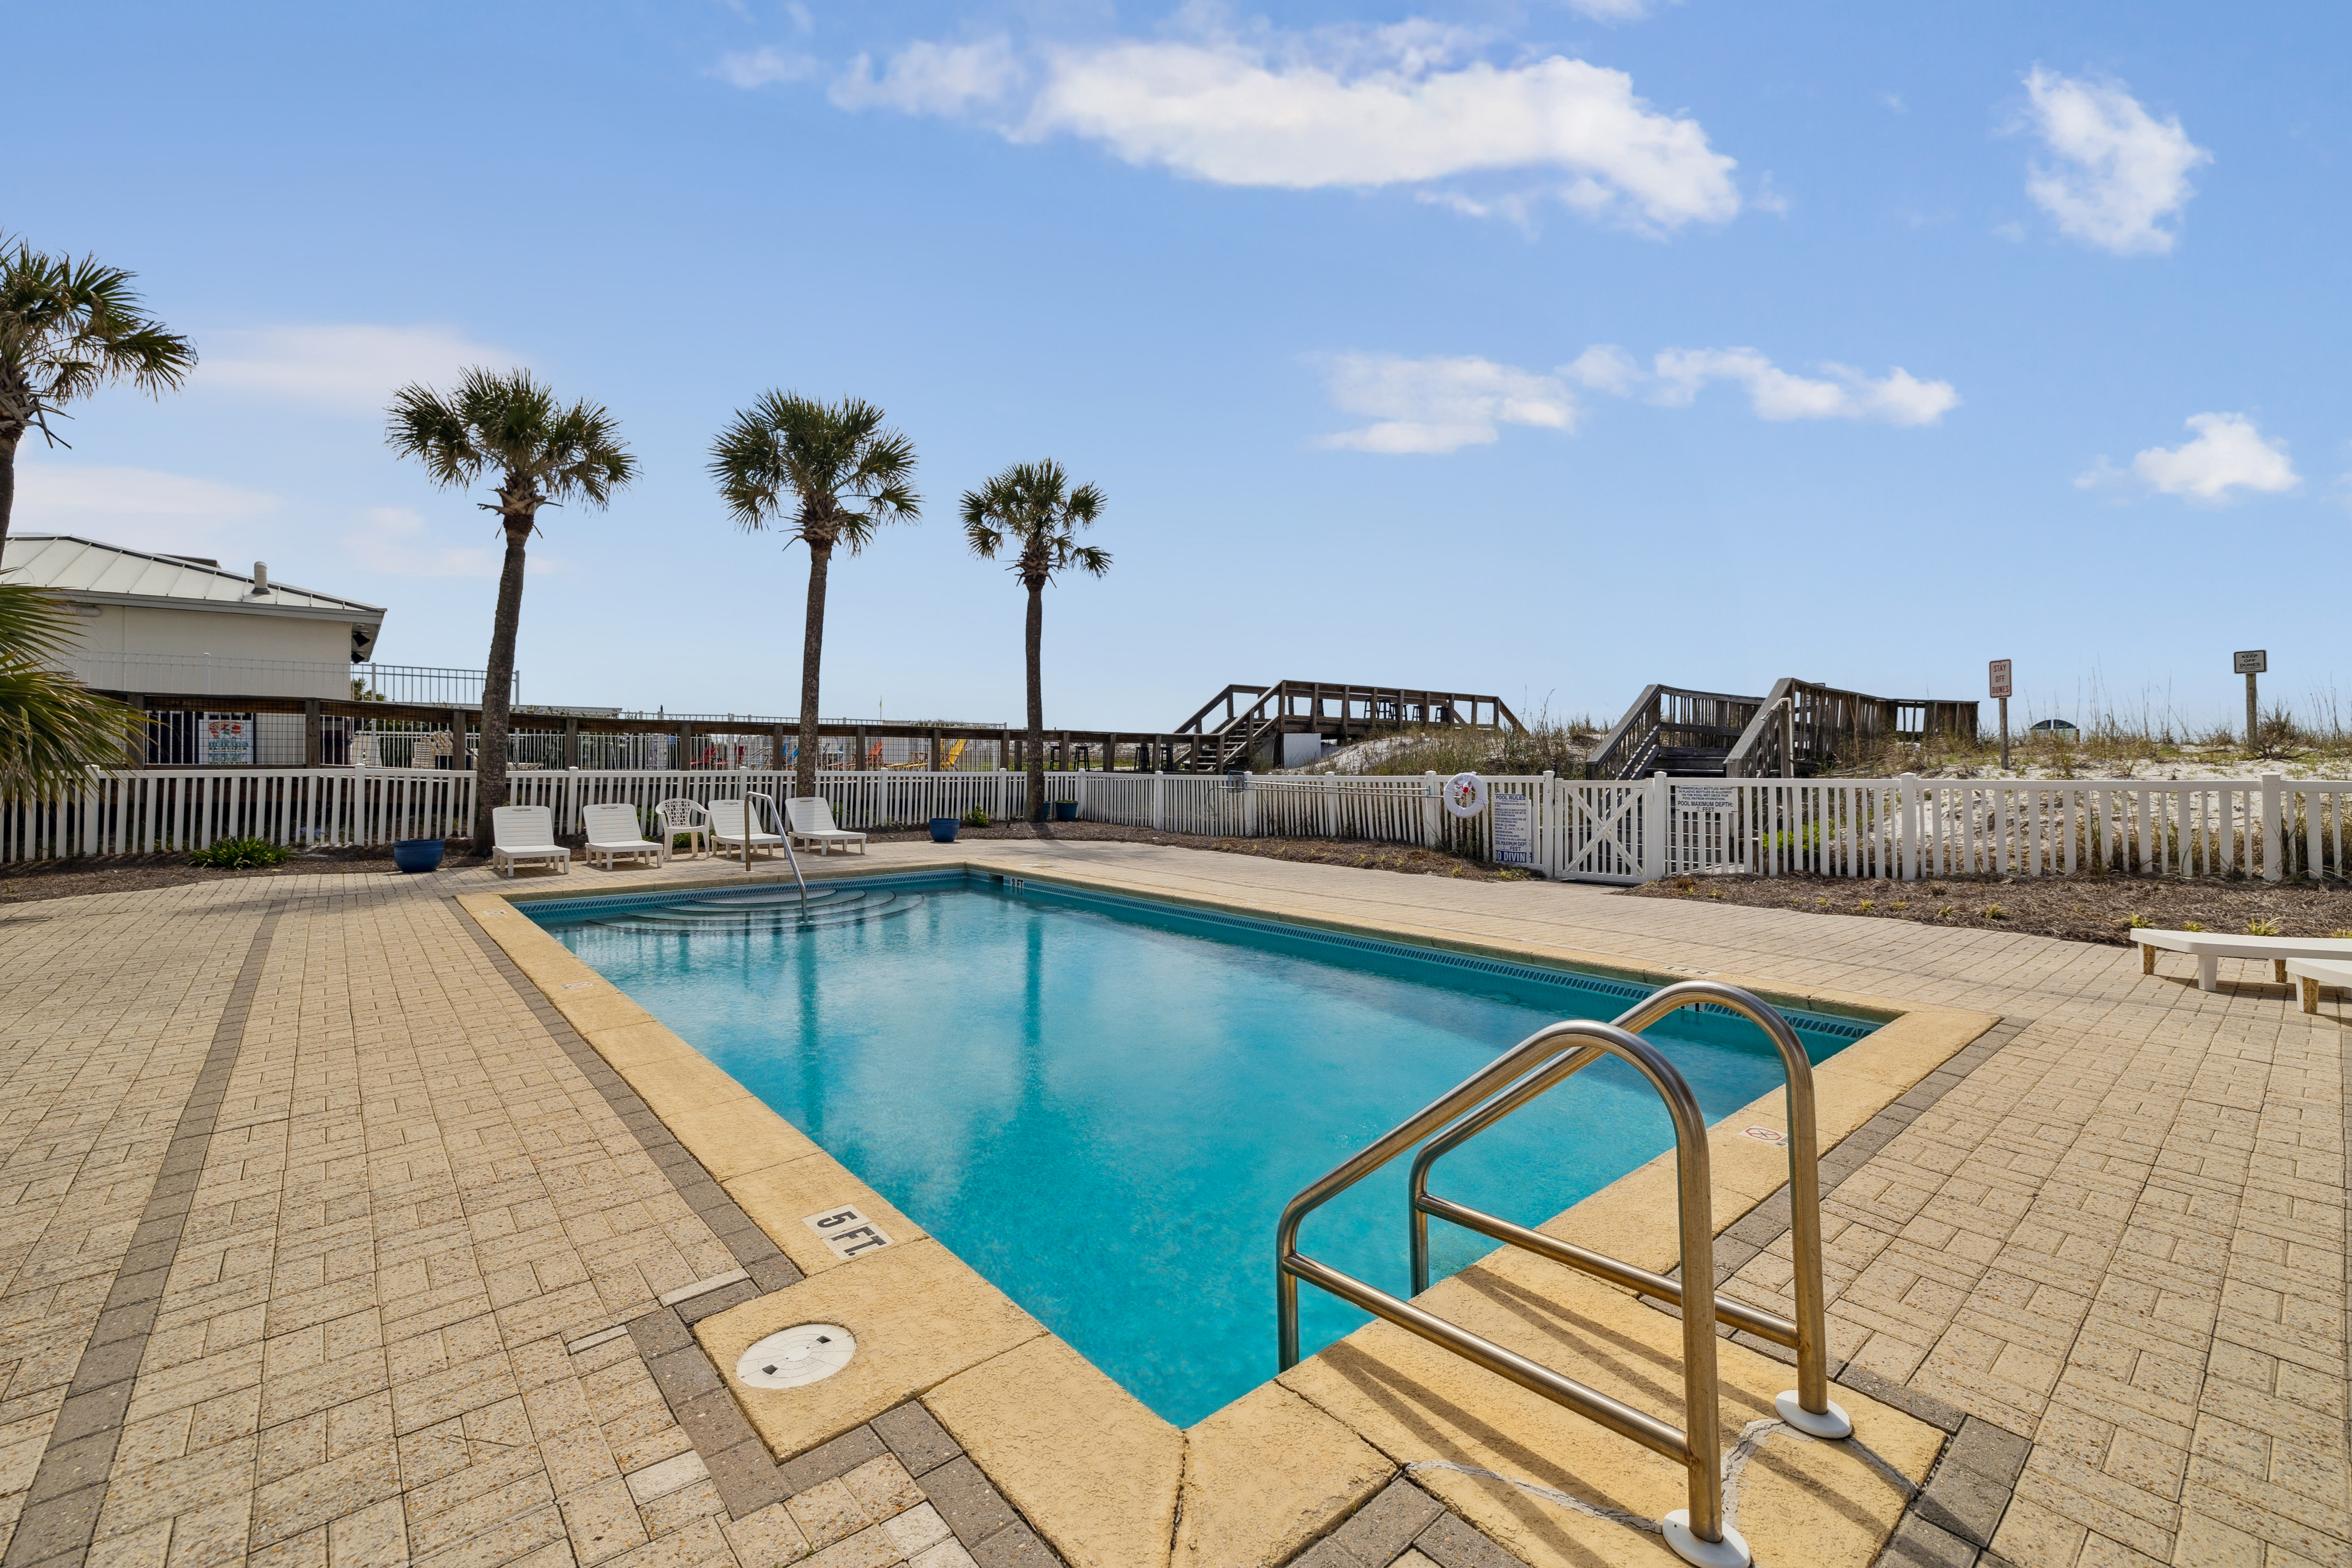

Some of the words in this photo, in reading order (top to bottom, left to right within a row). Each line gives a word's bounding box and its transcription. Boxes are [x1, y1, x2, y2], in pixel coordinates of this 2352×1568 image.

[1994, 664, 2006, 672] STAY
[1992, 685, 2009, 693] DUNES
[1504, 851, 1531, 862] DIVIN
[1017, 879, 1023, 888] FT
[817, 1211, 858, 1228] 5
[831, 1226, 887, 1256] FT.
